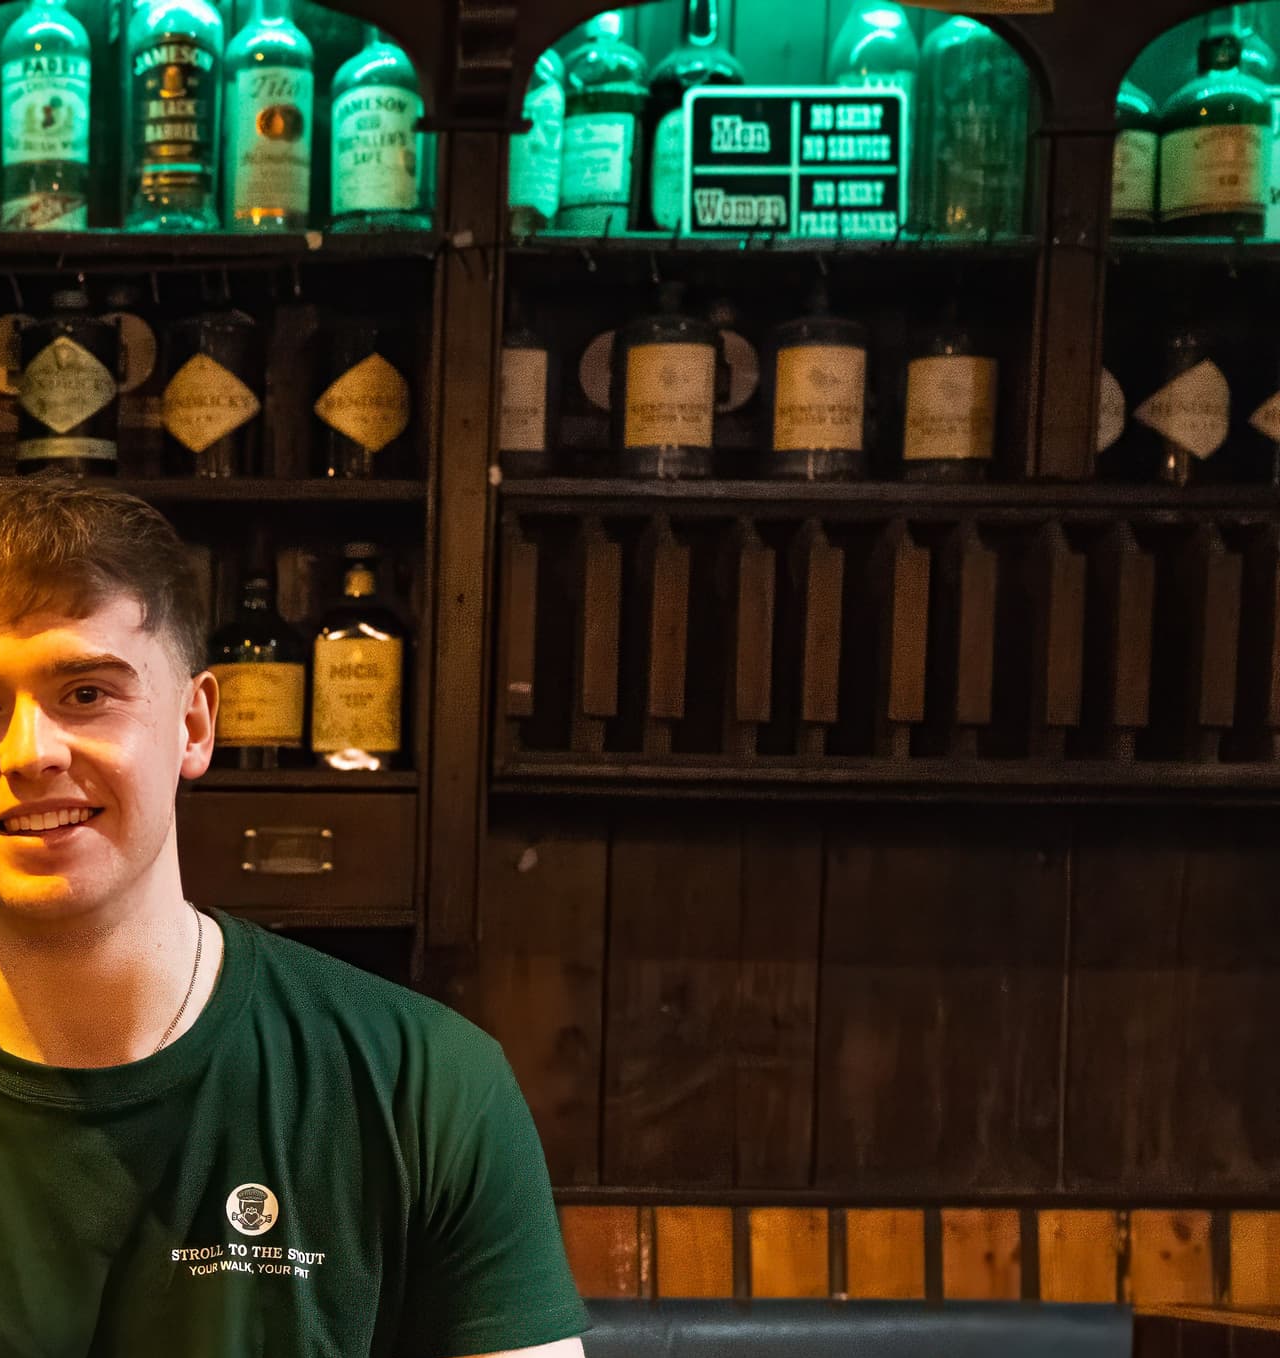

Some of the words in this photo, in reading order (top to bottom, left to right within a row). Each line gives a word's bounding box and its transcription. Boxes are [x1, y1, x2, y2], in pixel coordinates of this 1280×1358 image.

[134, 45, 214, 76] JAMESON
[810, 104, 835, 130] NO
[712, 115, 771, 153] Men
[802, 135, 826, 160] NO
[827, 135, 891, 160] SERVICE
[813, 181, 836, 206] NO
[694, 187, 788, 226] Women
[171, 1245, 224, 1261] STROLL
[228, 1243, 248, 1257] TO
[252, 1246, 283, 1259] THE
[287, 1248, 325, 1265] STOUT
[189, 1262, 218, 1276] YOUR
[220, 1260, 254, 1274] WALK,
[257, 1263, 291, 1275] YOUR
